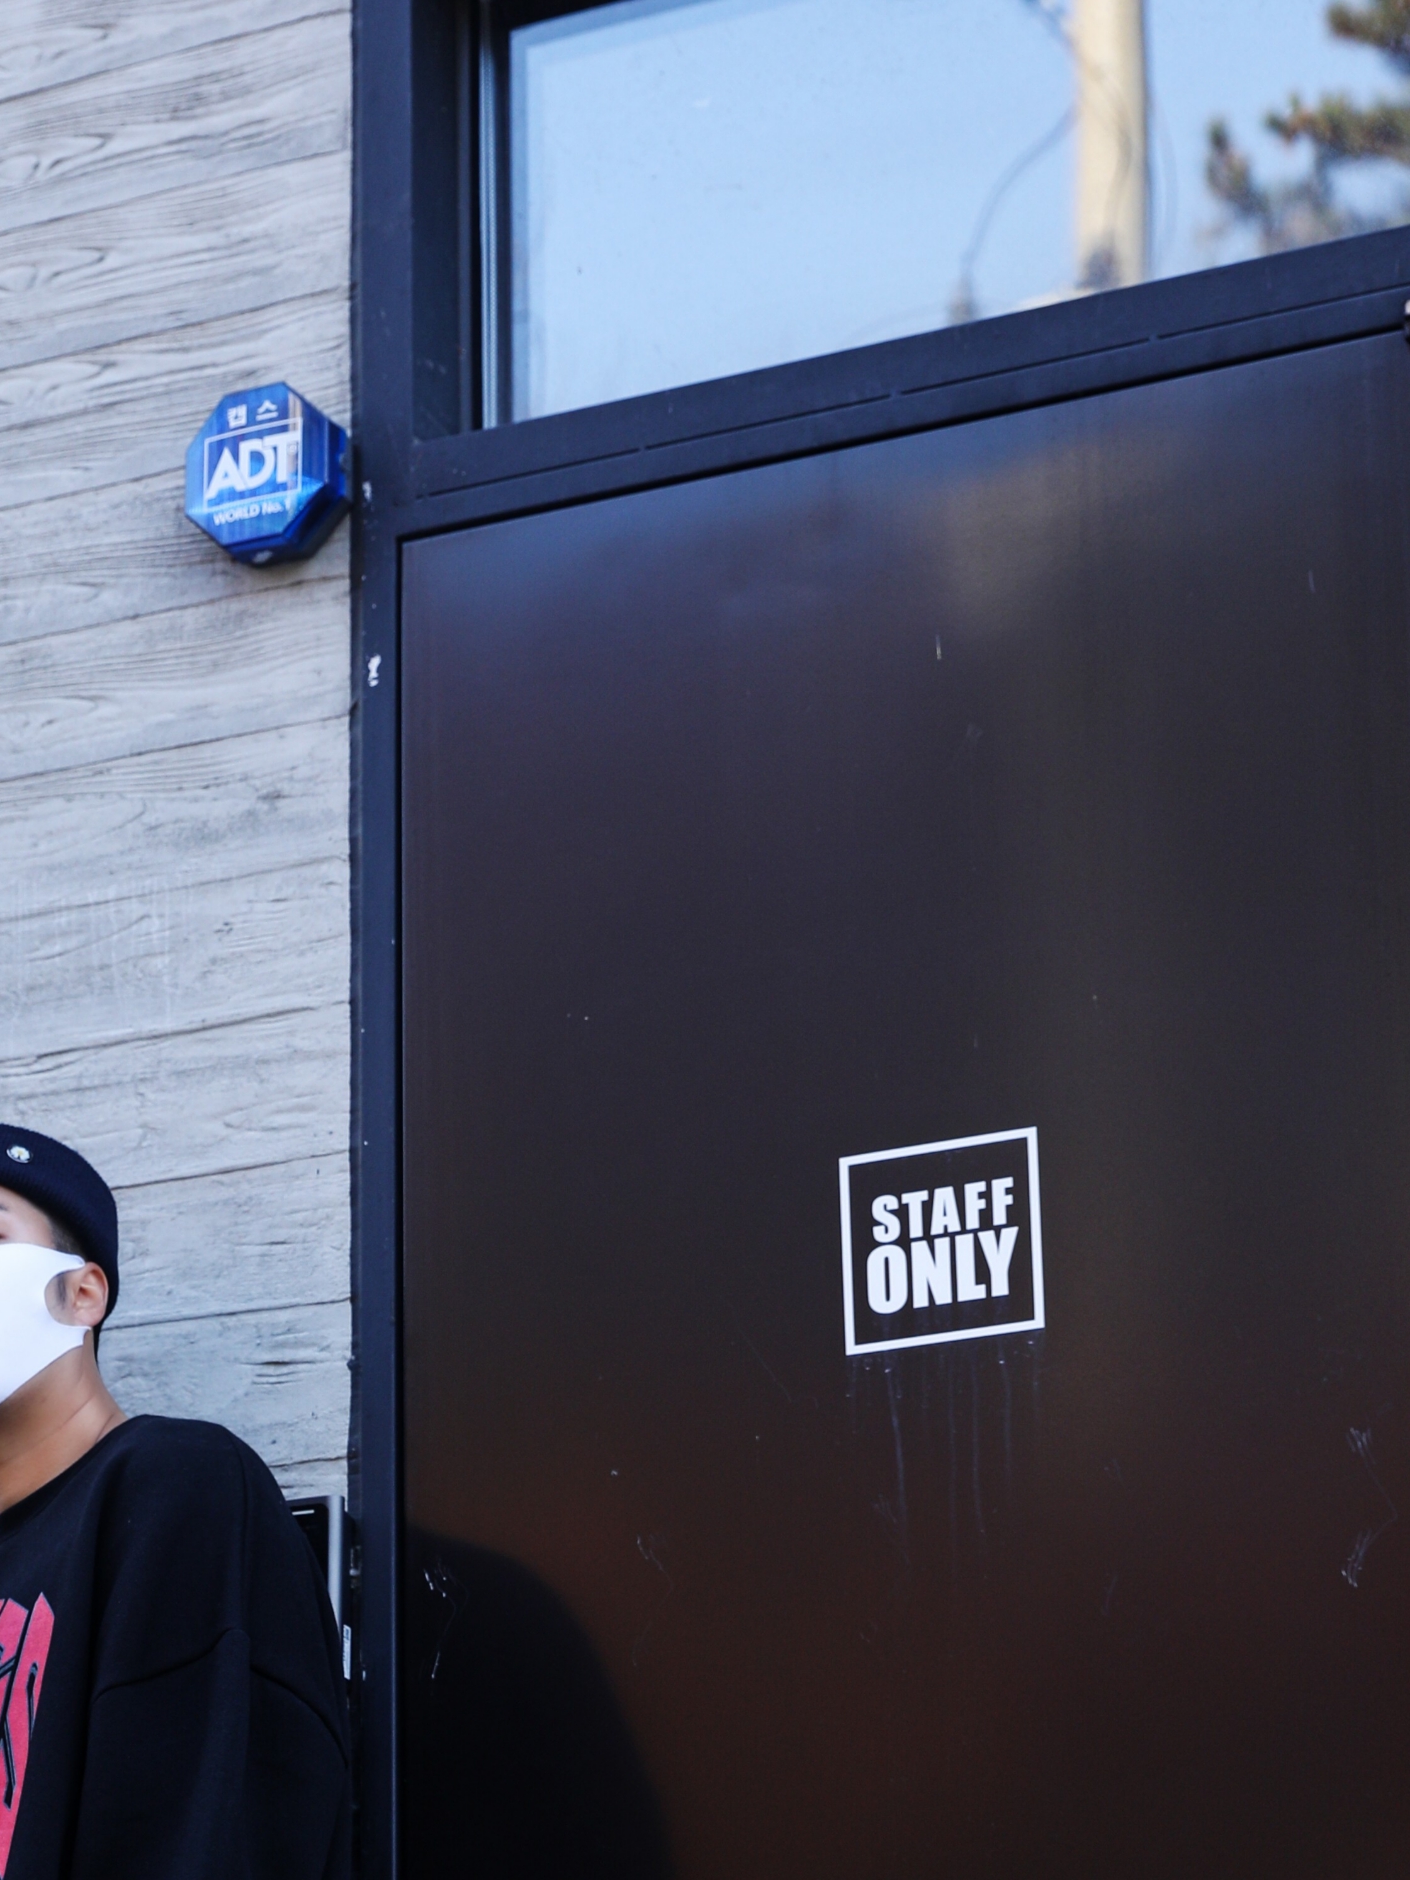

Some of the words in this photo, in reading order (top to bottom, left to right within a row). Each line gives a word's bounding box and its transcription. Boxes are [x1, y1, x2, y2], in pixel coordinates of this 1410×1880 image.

[204, 430, 300, 500] ADT
[213, 504, 260, 526] WORLD
[871, 1176, 1014, 1244] STAFF
[866, 1226, 1019, 1315] ONLY
